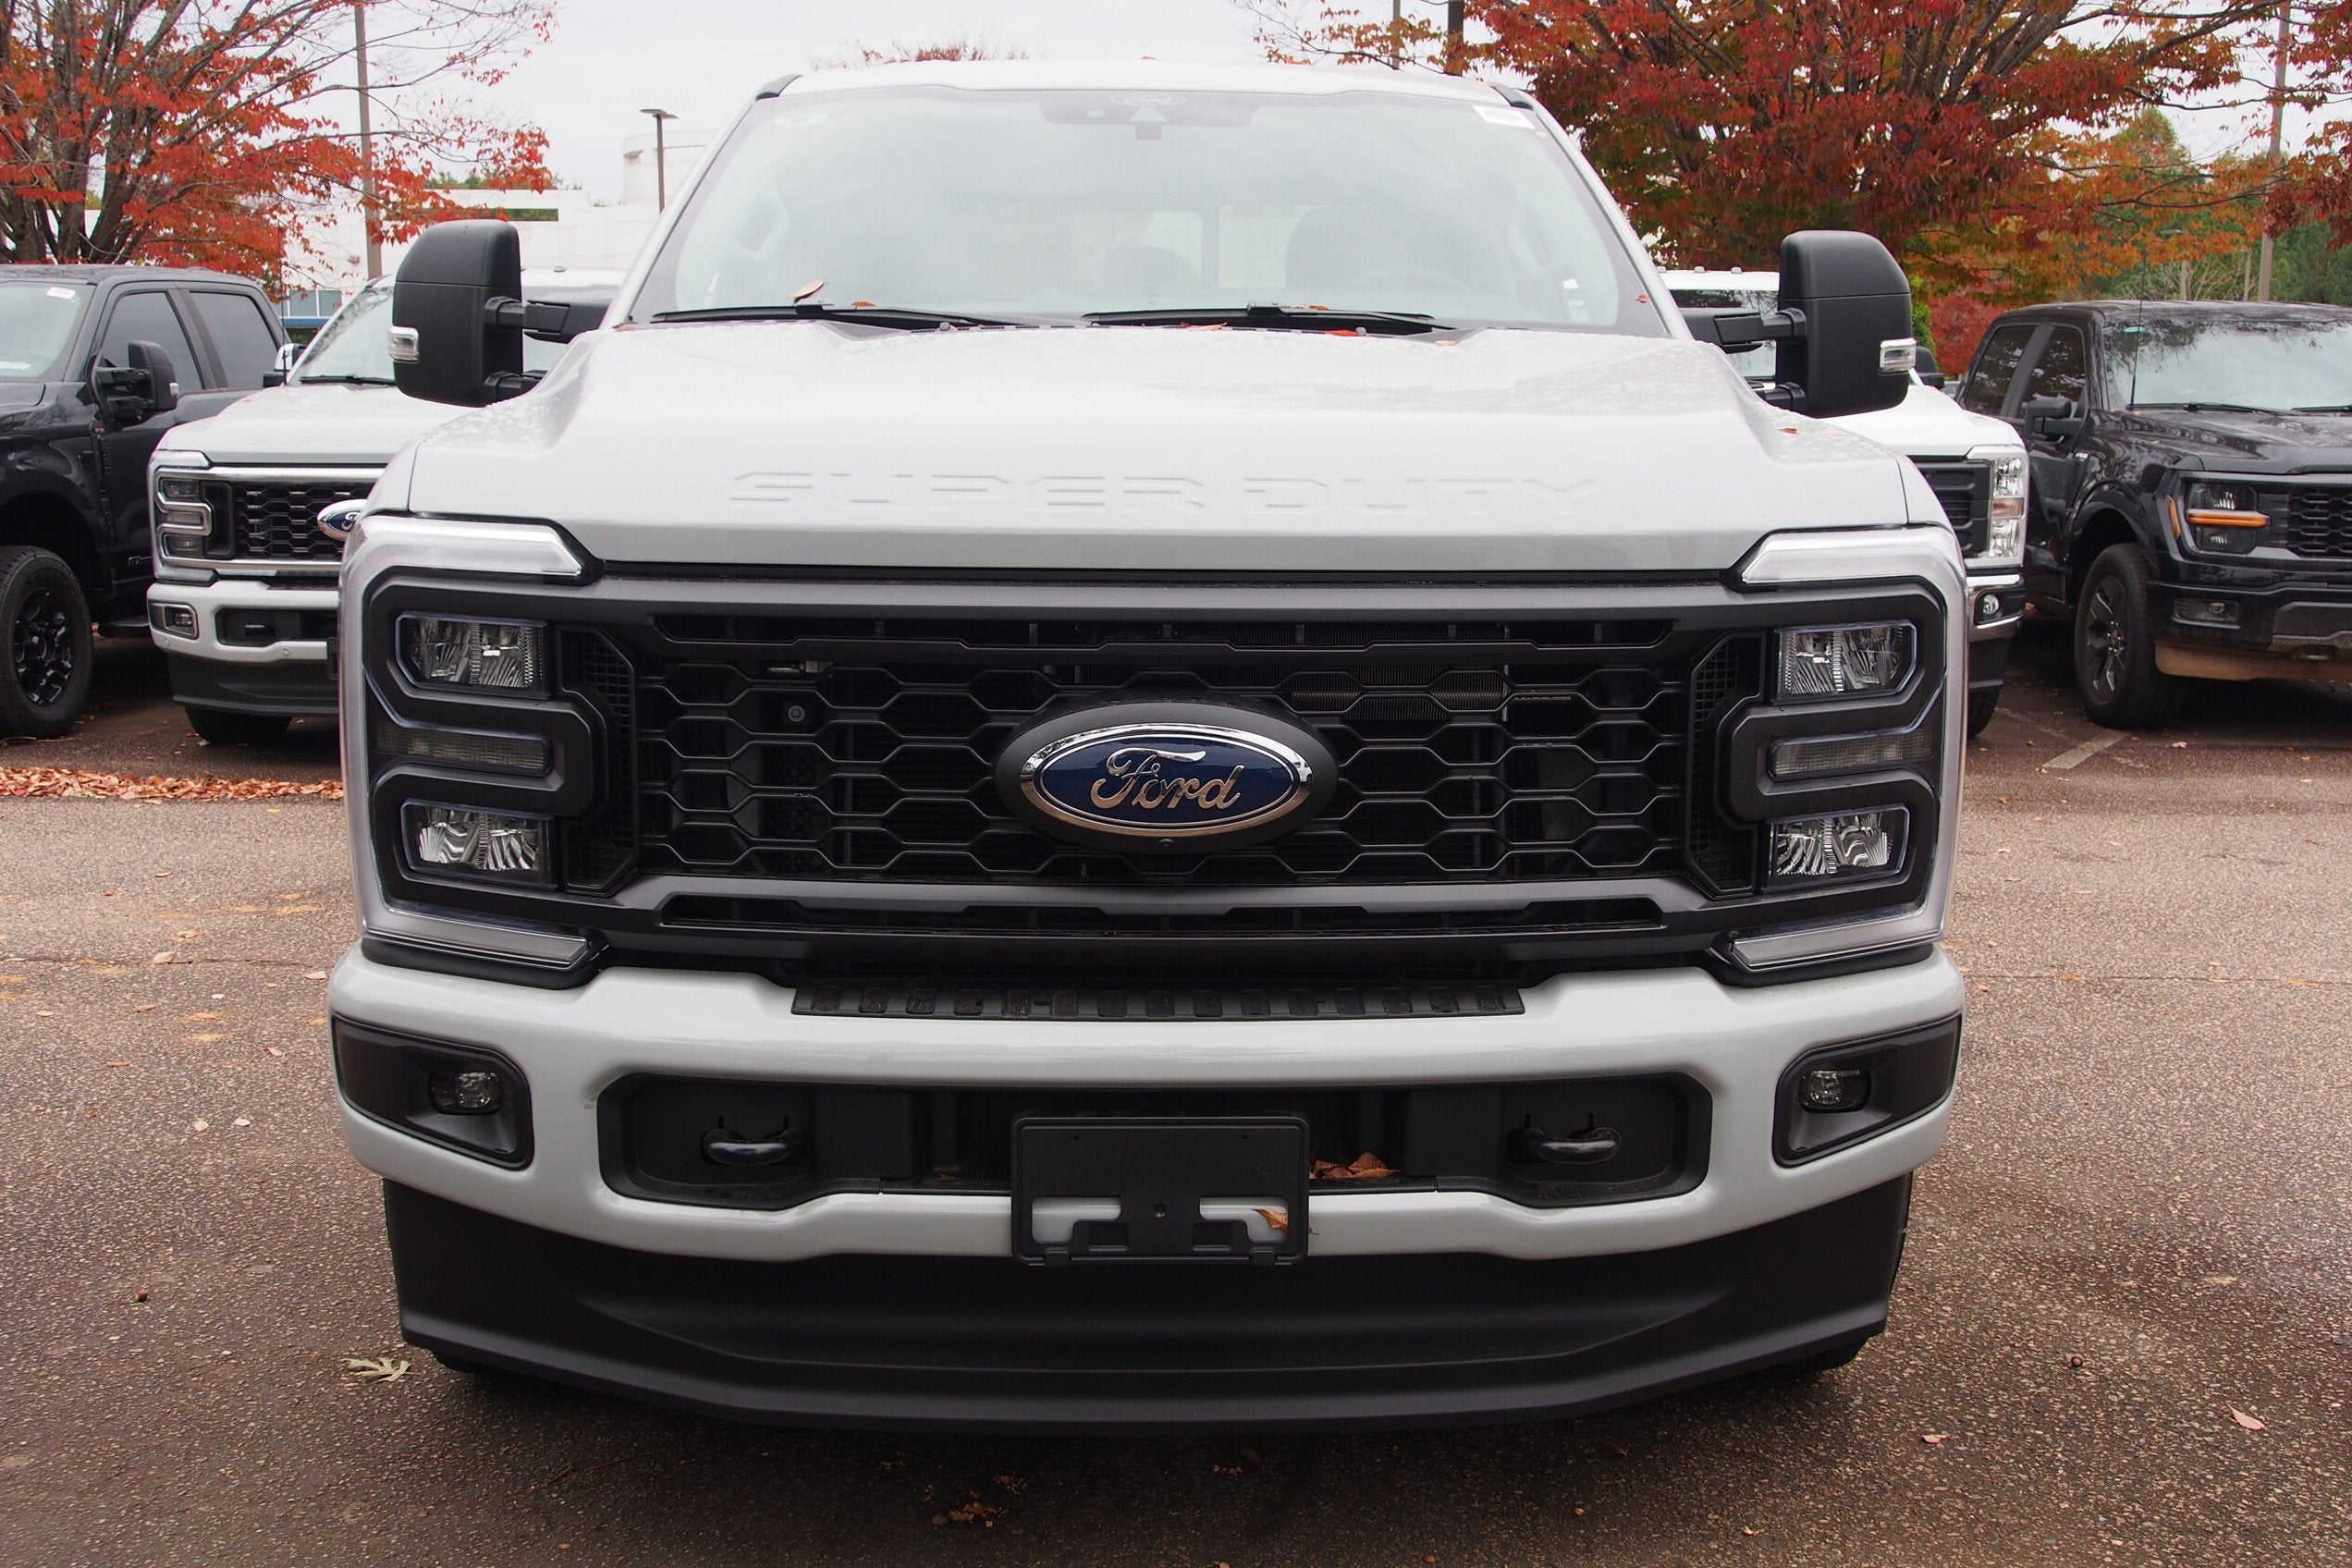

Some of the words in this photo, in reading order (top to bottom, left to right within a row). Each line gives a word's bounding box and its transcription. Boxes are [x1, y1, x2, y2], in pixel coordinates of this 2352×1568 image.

[729, 472, 1206, 513] SUPER
[1243, 477, 1599, 516] DUTY
[1091, 747, 1244, 810] Ford
